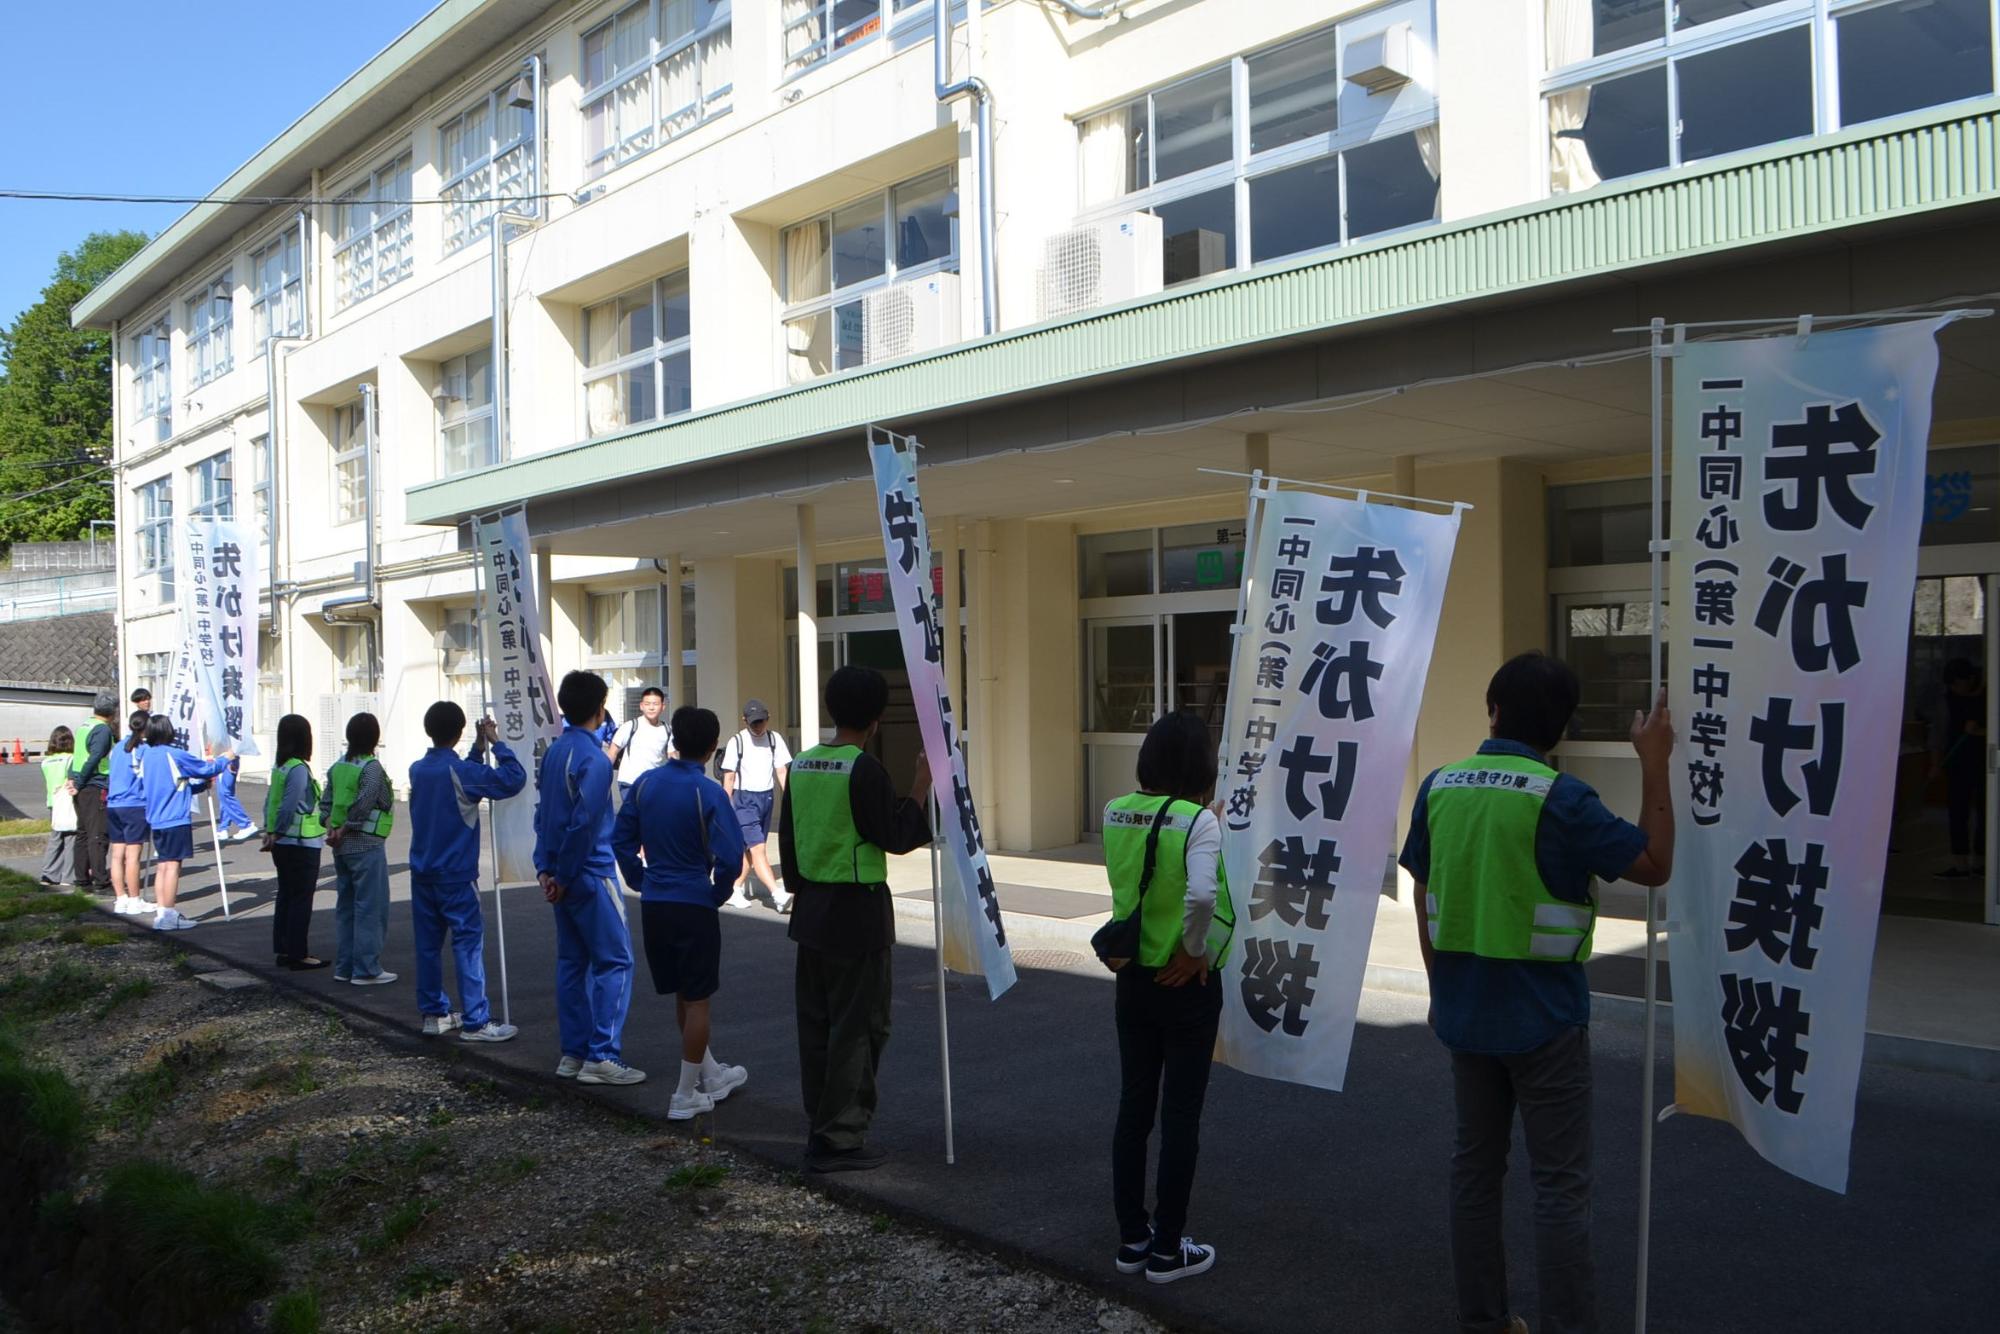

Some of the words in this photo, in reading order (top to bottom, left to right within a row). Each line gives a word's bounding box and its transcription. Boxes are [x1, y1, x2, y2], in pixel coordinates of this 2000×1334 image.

[1444, 771, 1529, 788] こども見守り隊
[1110, 812, 1174, 826] こども見守隊
